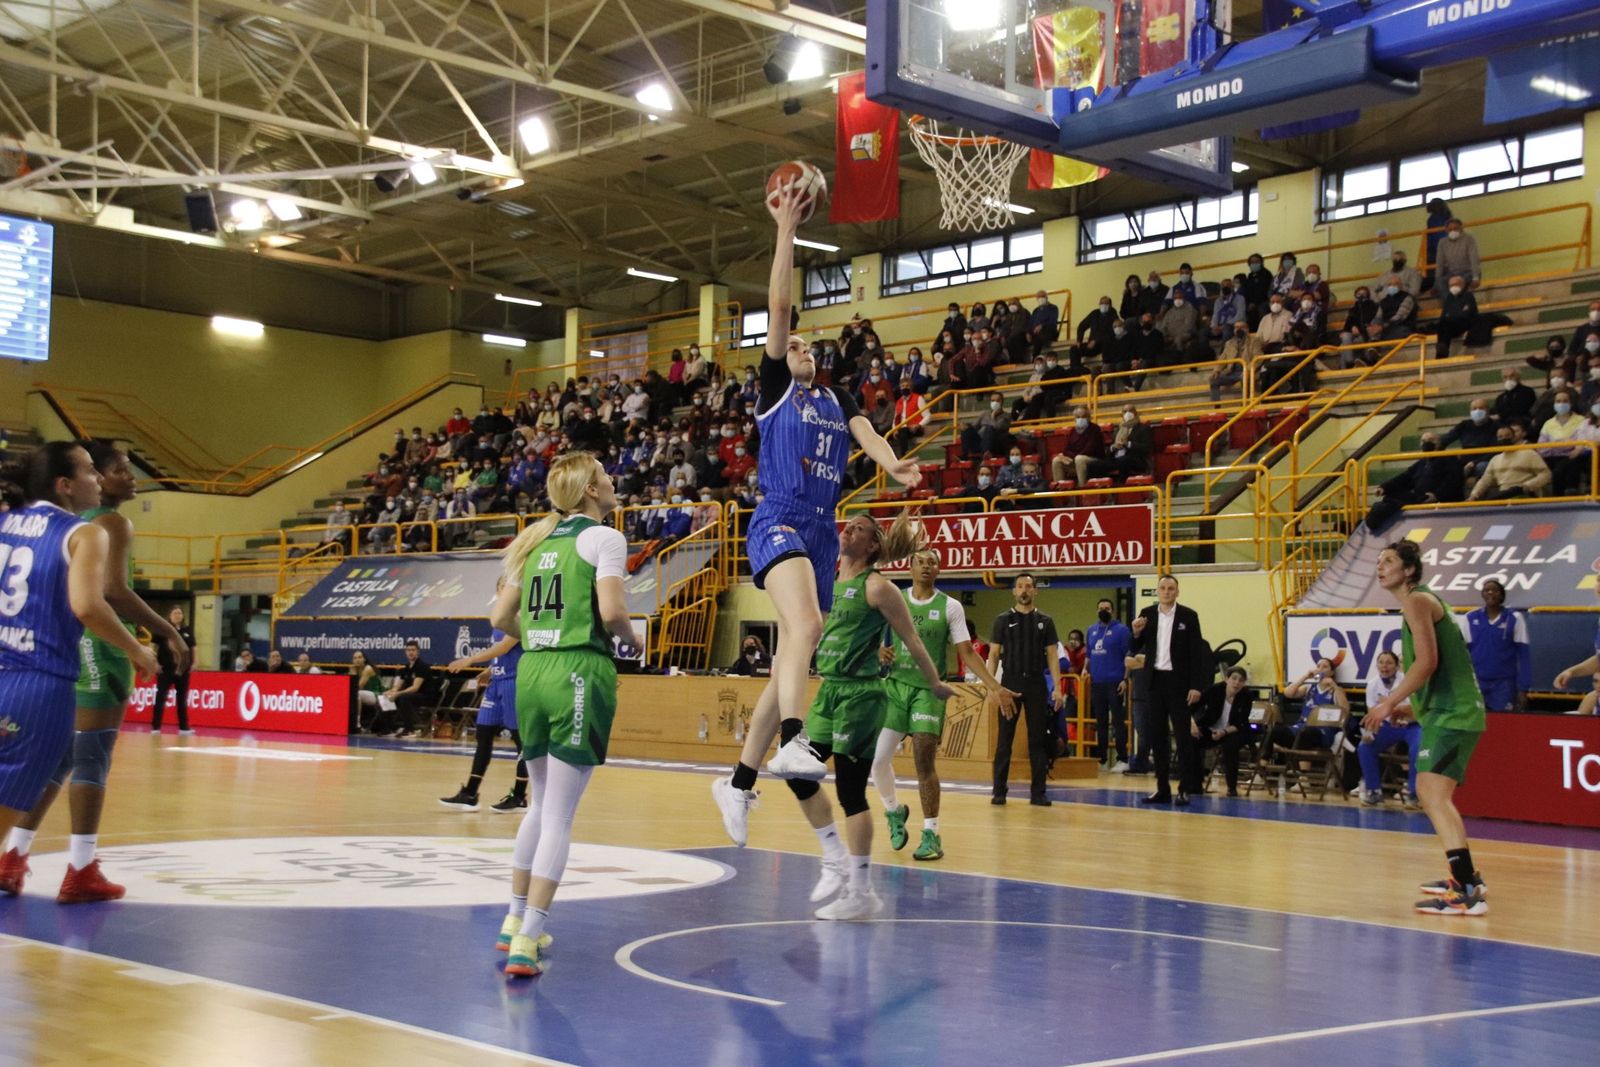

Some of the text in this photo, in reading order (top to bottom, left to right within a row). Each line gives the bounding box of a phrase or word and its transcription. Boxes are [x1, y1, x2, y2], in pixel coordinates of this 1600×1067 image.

[1427, 0, 1511, 27] MONDO
[1176, 77, 1243, 109] MONDO
[815, 432, 833, 459] 31
[911, 510, 1106, 547] LAMANCA
[538, 552, 558, 569] ZEC
[947, 547, 974, 568] DE
[980, 546, 1004, 567] LA
[1011, 540, 1143, 566] HUMANIDAD
[1421, 543, 1577, 566] ASTILLA
[332, 580, 399, 593] CASTILLA
[528, 573, 564, 620] 44
[335, 594, 375, 608] LEÓN
[913, 615, 924, 625] 22
[0, 624, 35, 654] ANCA
[201, 690, 224, 709] can
[262, 689, 323, 713] vodafone
[571, 676, 585, 746] EL CORREO
